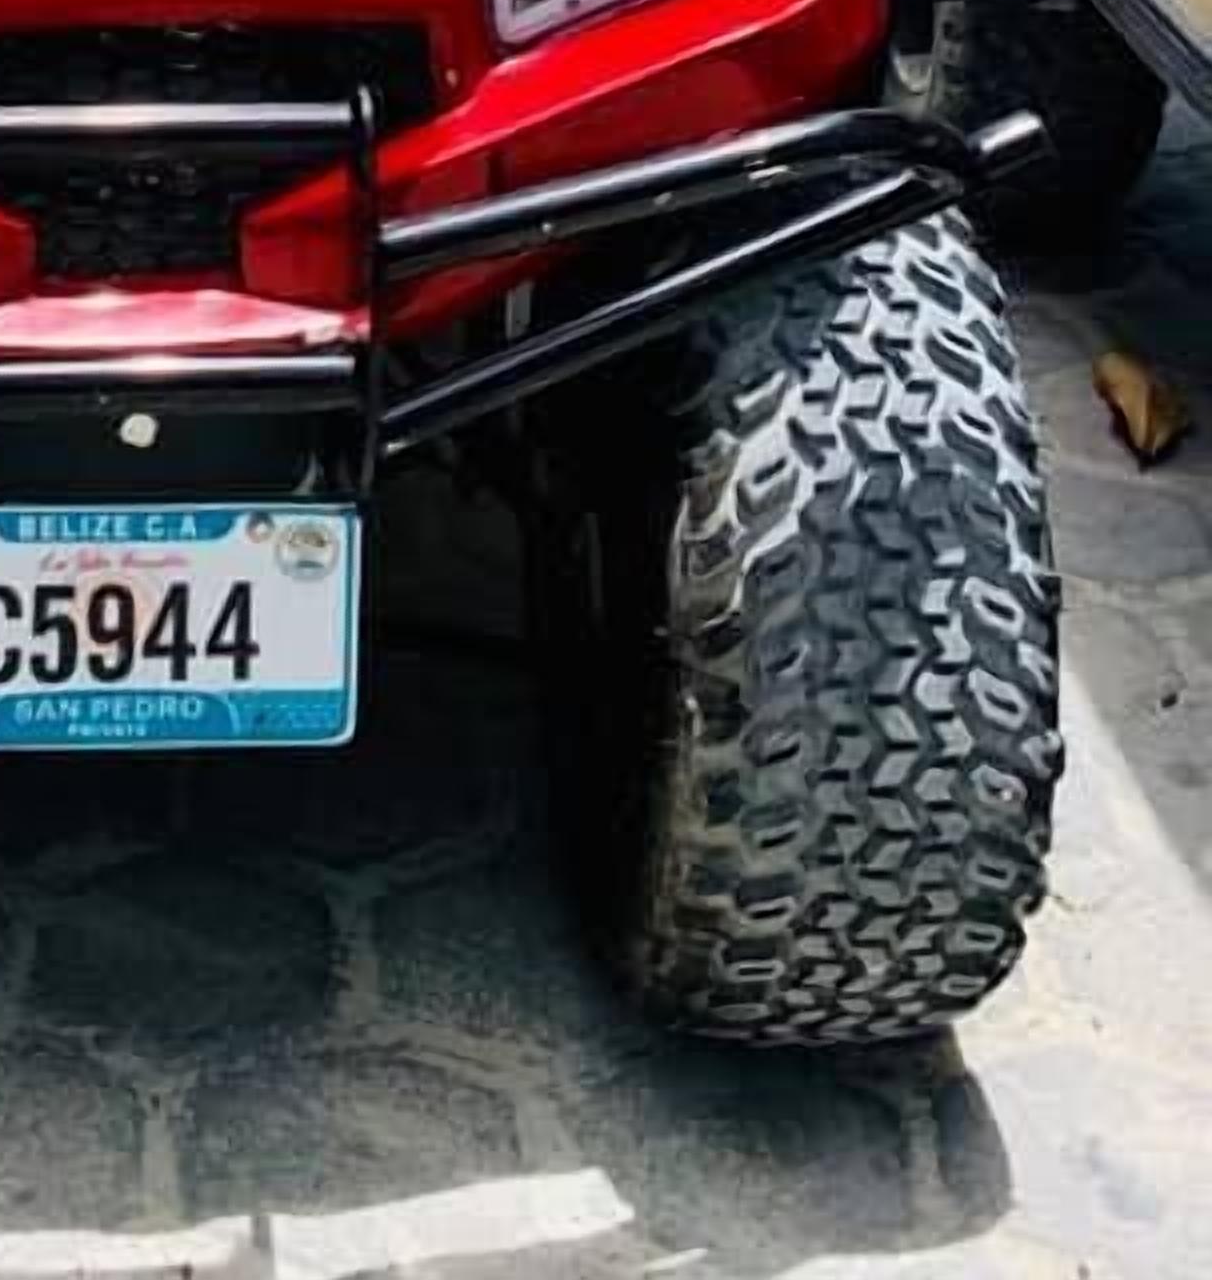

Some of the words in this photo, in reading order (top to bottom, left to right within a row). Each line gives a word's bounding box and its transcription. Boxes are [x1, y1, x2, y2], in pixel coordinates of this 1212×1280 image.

[17, 514, 130, 539] BELIZE
[13, 698, 80, 724] SAN
[90, 694, 204, 722] PEDRO
